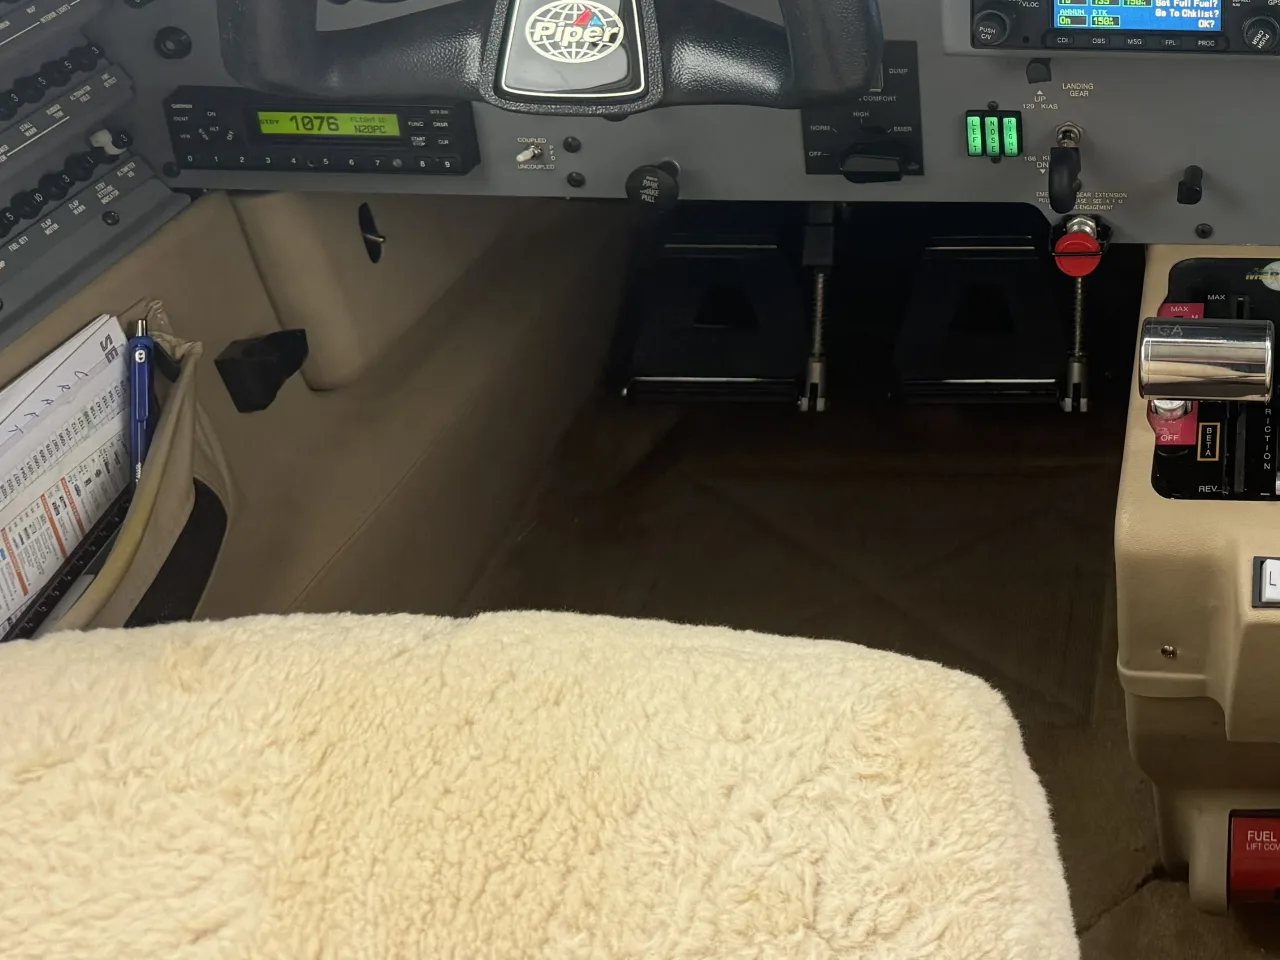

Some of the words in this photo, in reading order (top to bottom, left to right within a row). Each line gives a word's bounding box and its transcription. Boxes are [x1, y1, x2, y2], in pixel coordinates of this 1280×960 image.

[1174, 0, 1192, 7] Full
[533, 20, 621, 45] Piper
[289, 116, 339, 131] 1076
[1269, 572, 1276, 586] L
[1247, 830, 1277, 842] FUEL
